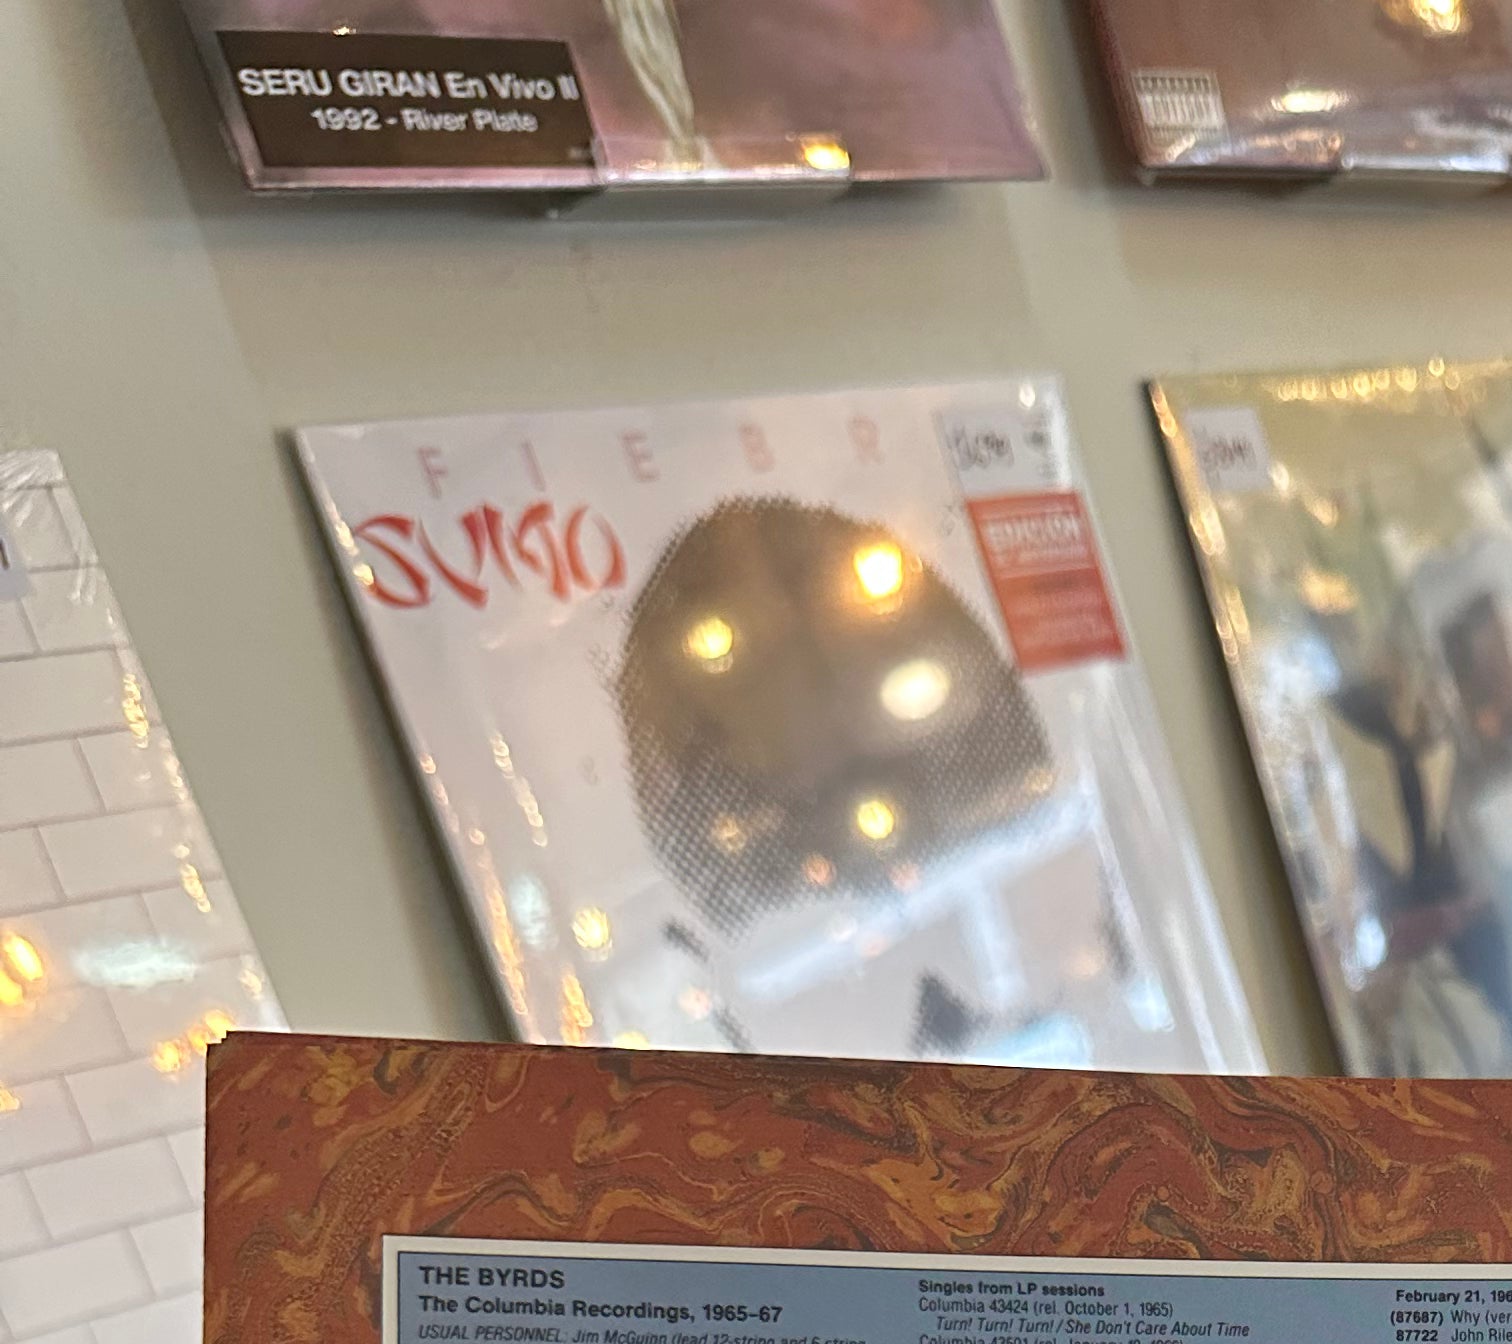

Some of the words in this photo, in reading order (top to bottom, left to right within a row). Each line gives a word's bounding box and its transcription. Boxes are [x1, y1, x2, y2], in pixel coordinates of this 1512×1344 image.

[239, 69, 332, 97] SERU
[338, 71, 440, 99] GIRAN
[445, 73, 488, 100] En
[488, 73, 556, 100] Vivo
[310, 107, 382, 131] 1992
[401, 108, 468, 131] River
[473, 109, 539, 133] Plate
[418, 1265, 469, 1286] THE
[478, 1267, 564, 1289] BYRDS
[417, 1295, 458, 1313] The
[464, 1295, 565, 1316] Columbia
[571, 1299, 694, 1323] Recordings,
[417, 1323, 469, 1340] USUAL
[571, 1329, 599, 1343] Jim
[602, 1328, 667, 1344] McGuinn
